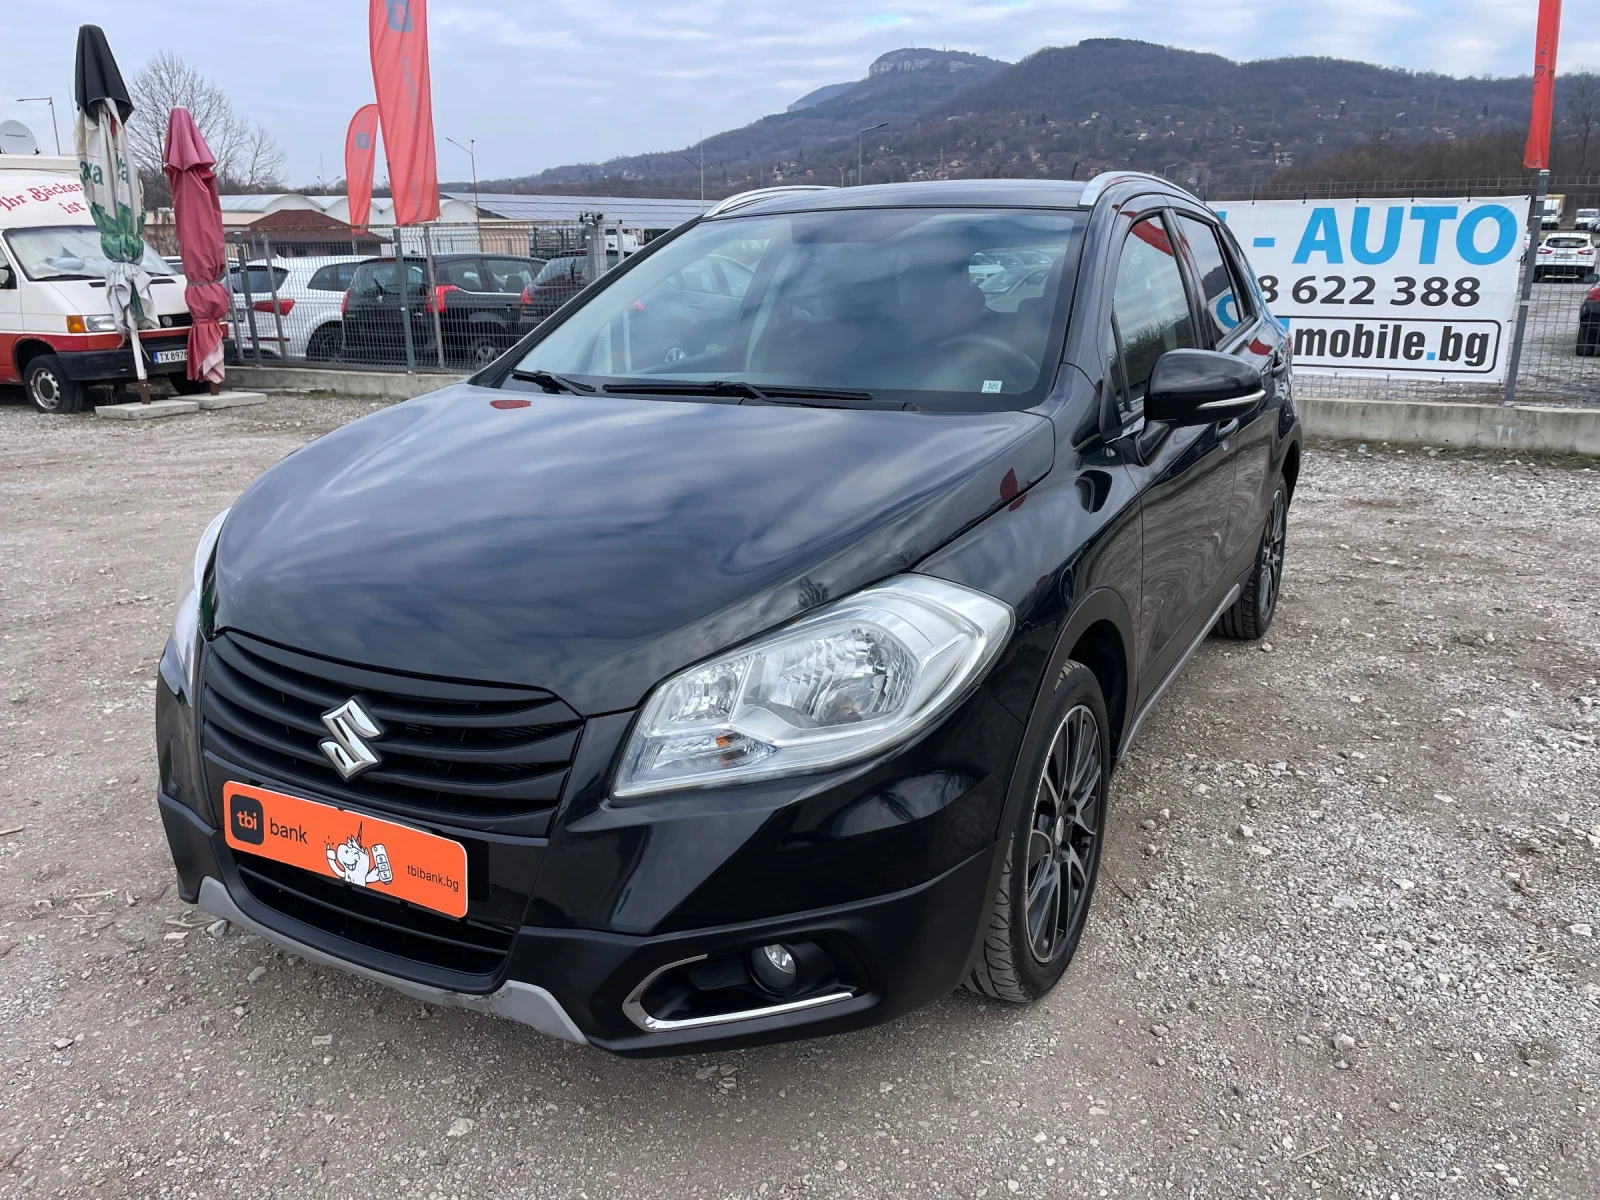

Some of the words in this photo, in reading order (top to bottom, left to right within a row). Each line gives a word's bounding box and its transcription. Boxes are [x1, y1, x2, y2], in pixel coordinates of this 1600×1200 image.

[58, 201, 86, 214] ist
[1292, 204, 1518, 266] AUTO
[1291, 275, 1376, 305] 622
[1389, 276, 1481, 307] 388
[1293, 323, 1489, 367] mobile.bg
[236, 810, 258, 831] tbi
[269, 817, 308, 845] bank
[407, 864, 459, 893] tbibank.bg
